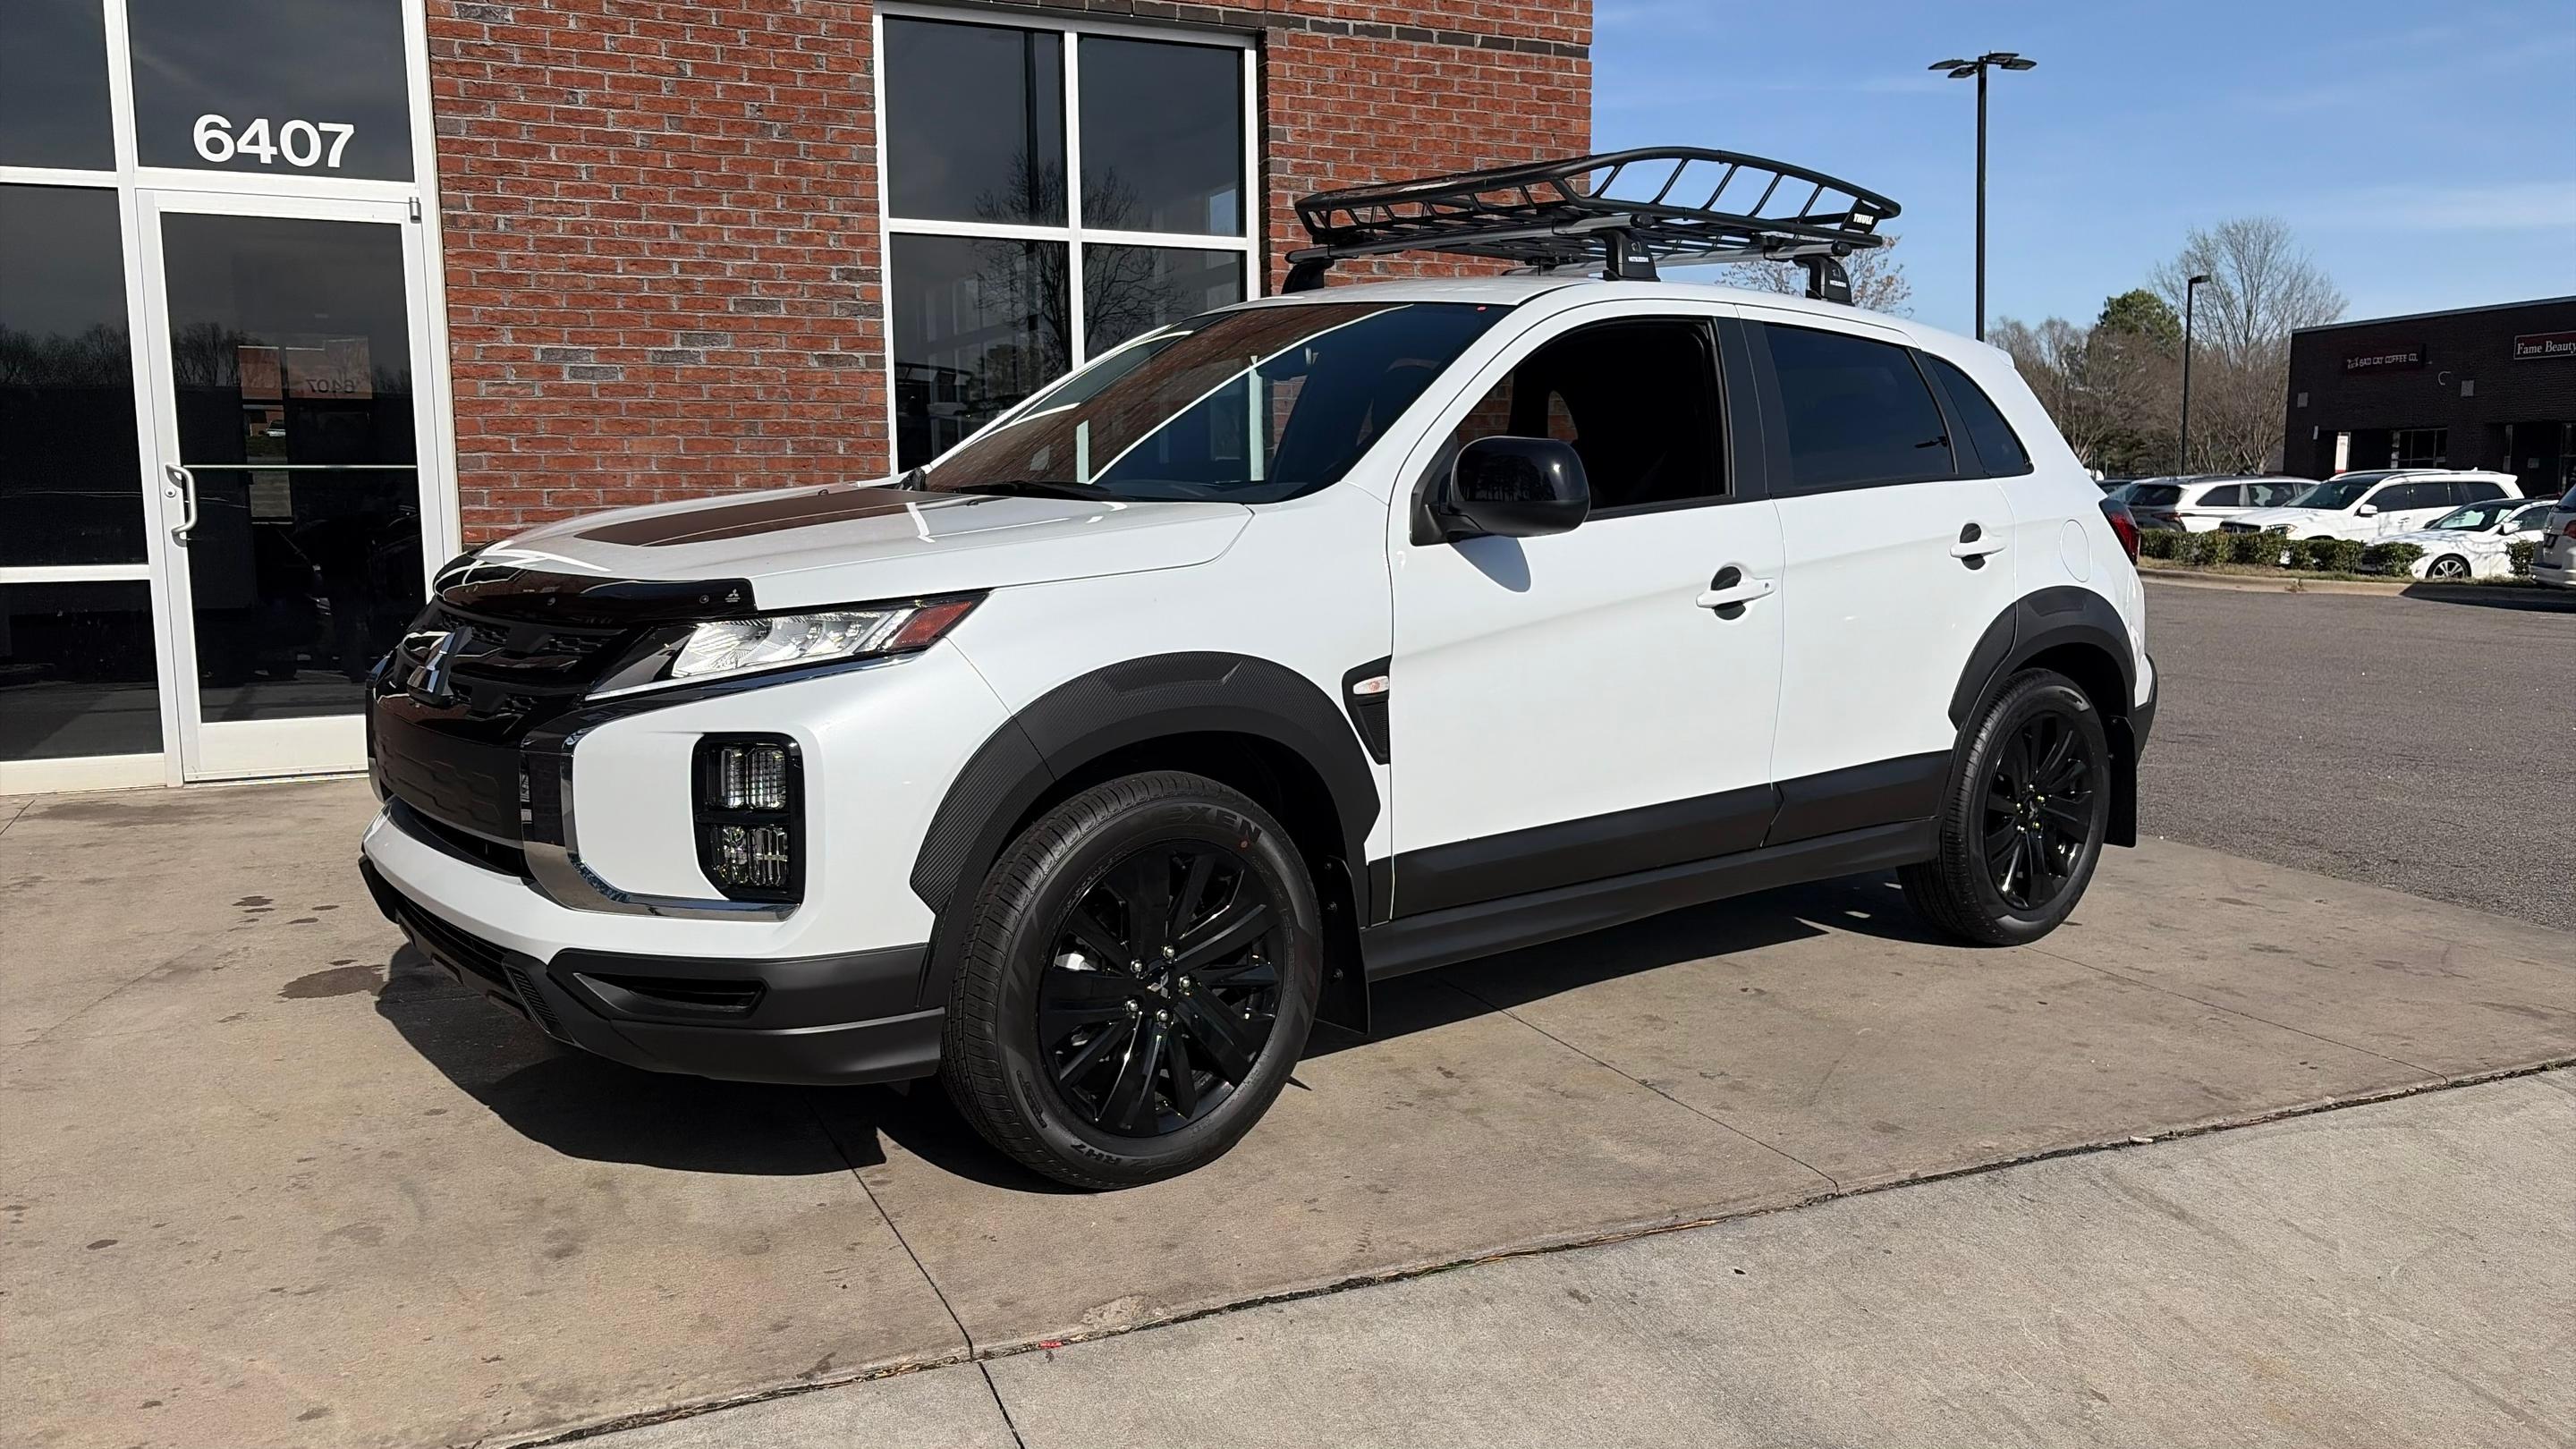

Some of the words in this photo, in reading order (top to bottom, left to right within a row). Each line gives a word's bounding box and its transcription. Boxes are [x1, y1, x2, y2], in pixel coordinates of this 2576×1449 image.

[193, 114, 355, 168] 6407
[1853, 213, 1874, 225] THULE
[2516, 343, 2543, 355] Fame
[2545, 340, 2576, 354] Beauty
[2385, 354, 2407, 364] COFFEE
[1163, 804, 1263, 843] EXEN
